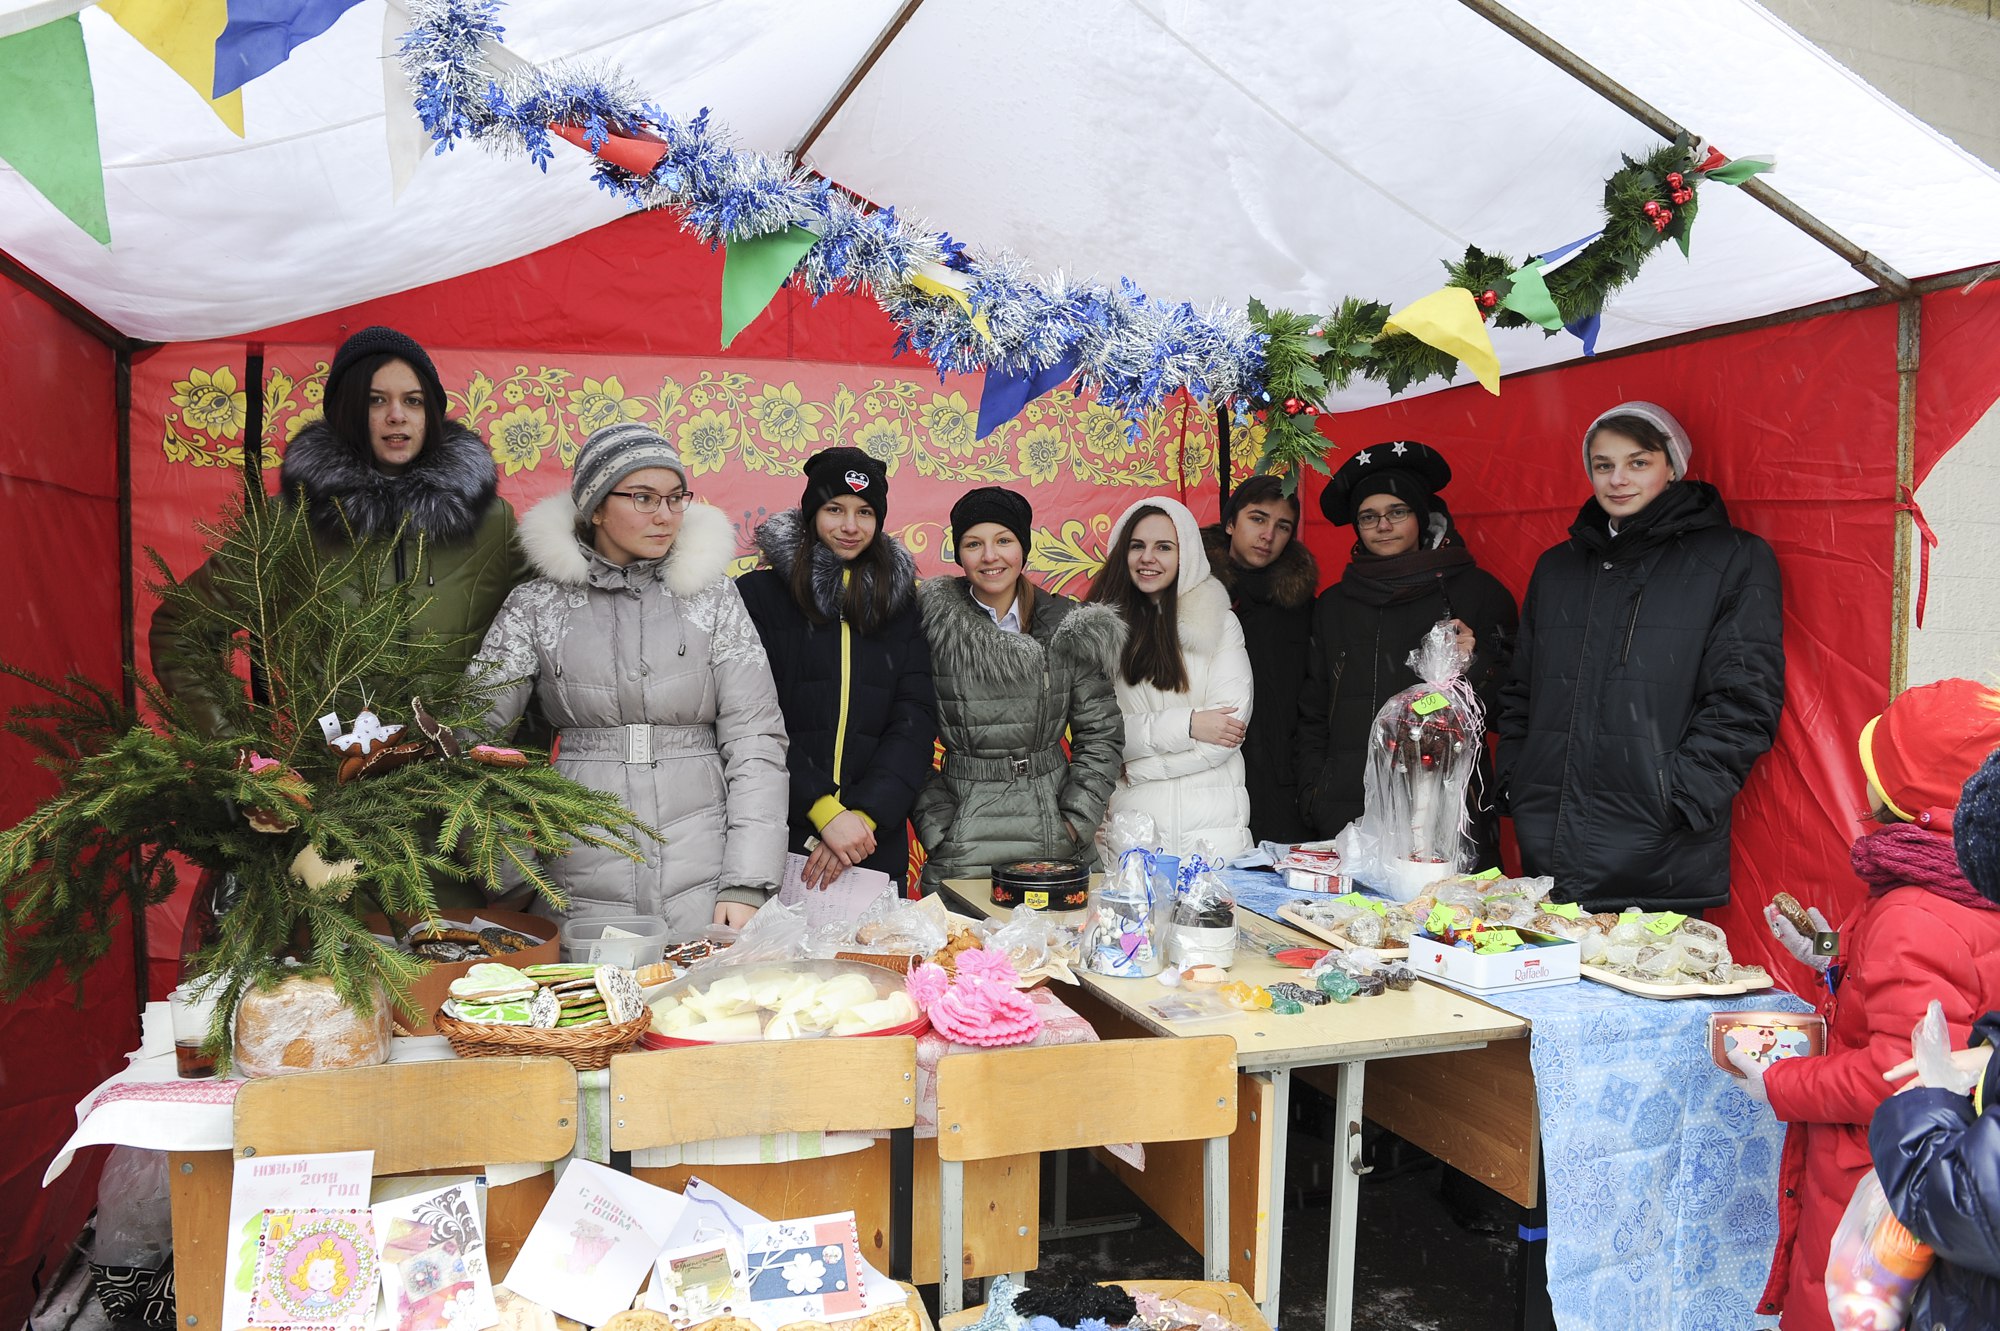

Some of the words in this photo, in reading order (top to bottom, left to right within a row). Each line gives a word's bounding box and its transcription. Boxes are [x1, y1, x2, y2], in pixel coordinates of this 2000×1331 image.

[1420, 695, 1436, 709] 500
[1488, 932, 1503, 942] 40
[1515, 966, 1550, 982] Raffaello
[253, 1160, 308, 1177] НОВЫЙ
[300, 1172, 338, 1186] 2018
[328, 1183, 361, 1197] ГОД
[579, 1187, 590, 1198] С
[583, 1202, 632, 1231] ГОДОМ
